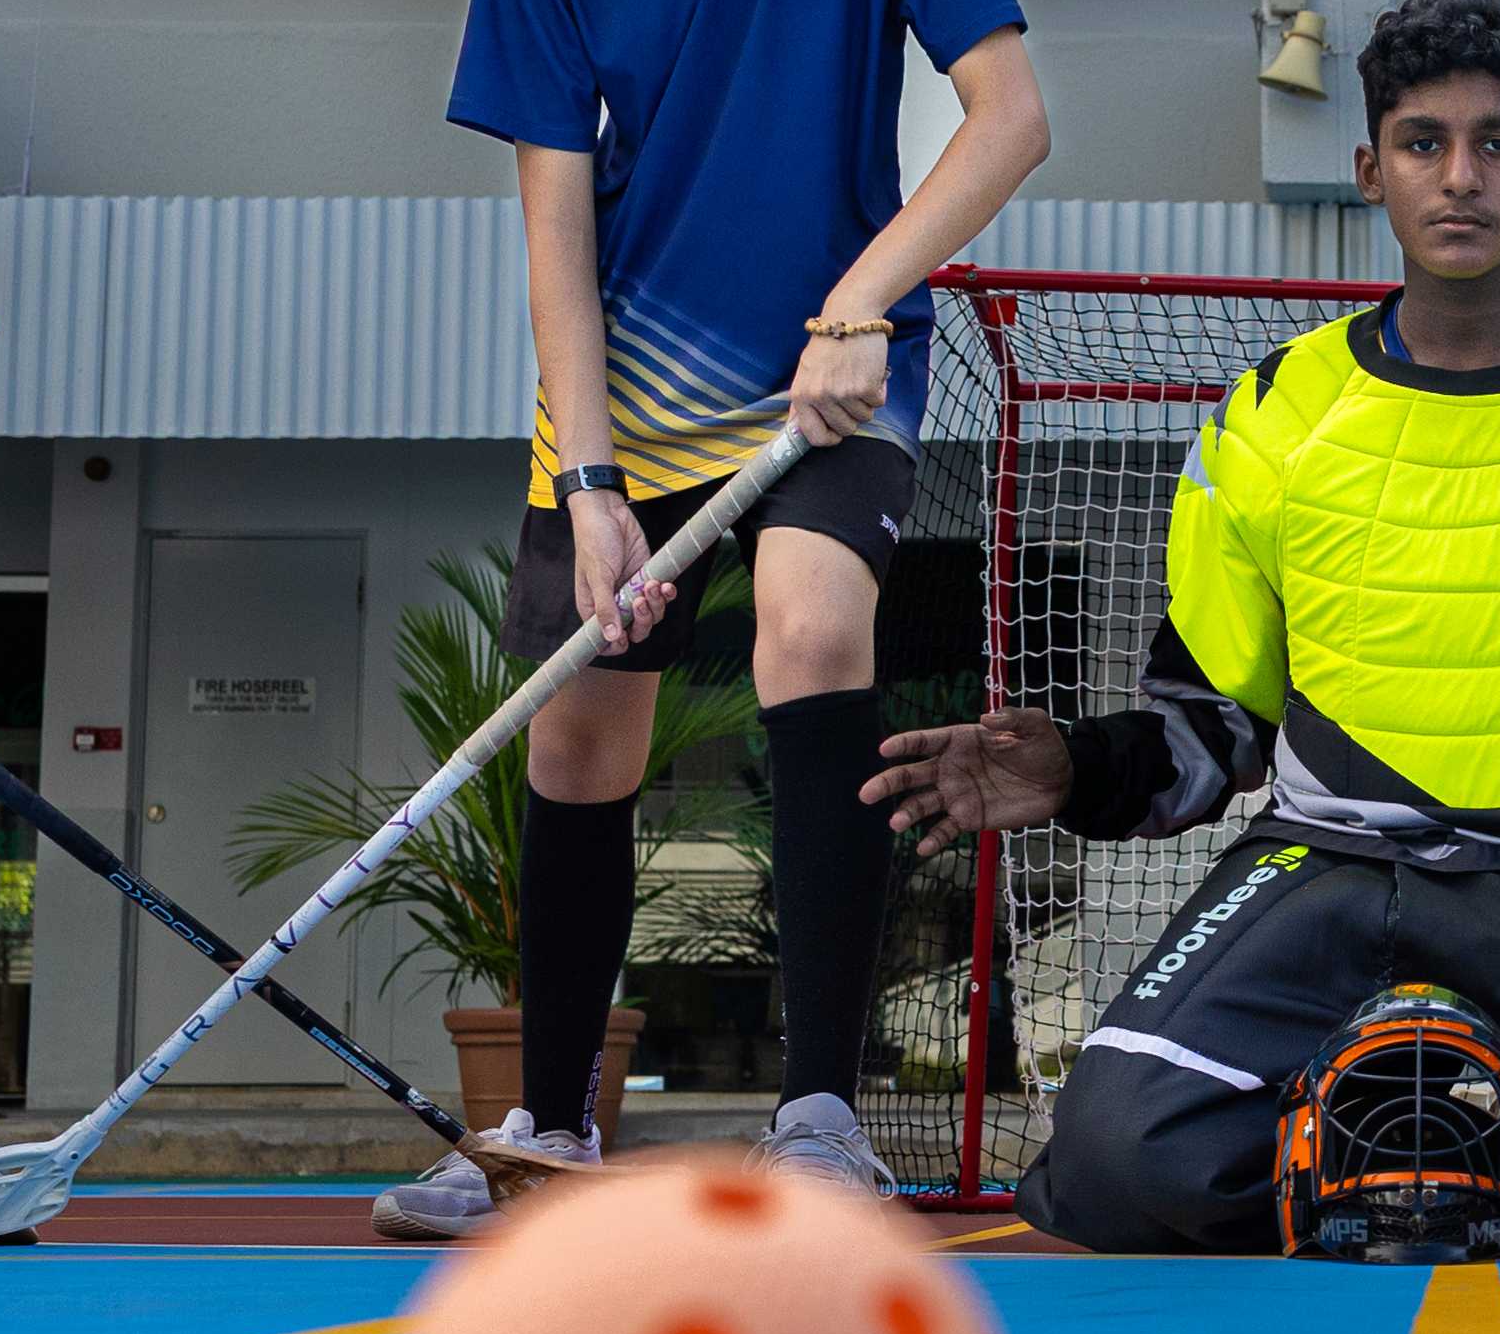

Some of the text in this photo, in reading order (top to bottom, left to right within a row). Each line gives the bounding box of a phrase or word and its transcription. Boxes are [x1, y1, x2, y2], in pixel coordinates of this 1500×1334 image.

[196, 679, 309, 694] FIRE HOSEREEL
[109, 873, 215, 955] OXDOG
[1133, 859, 1279, 1001] floorbee
[1320, 1218, 1368, 1243] MPS
